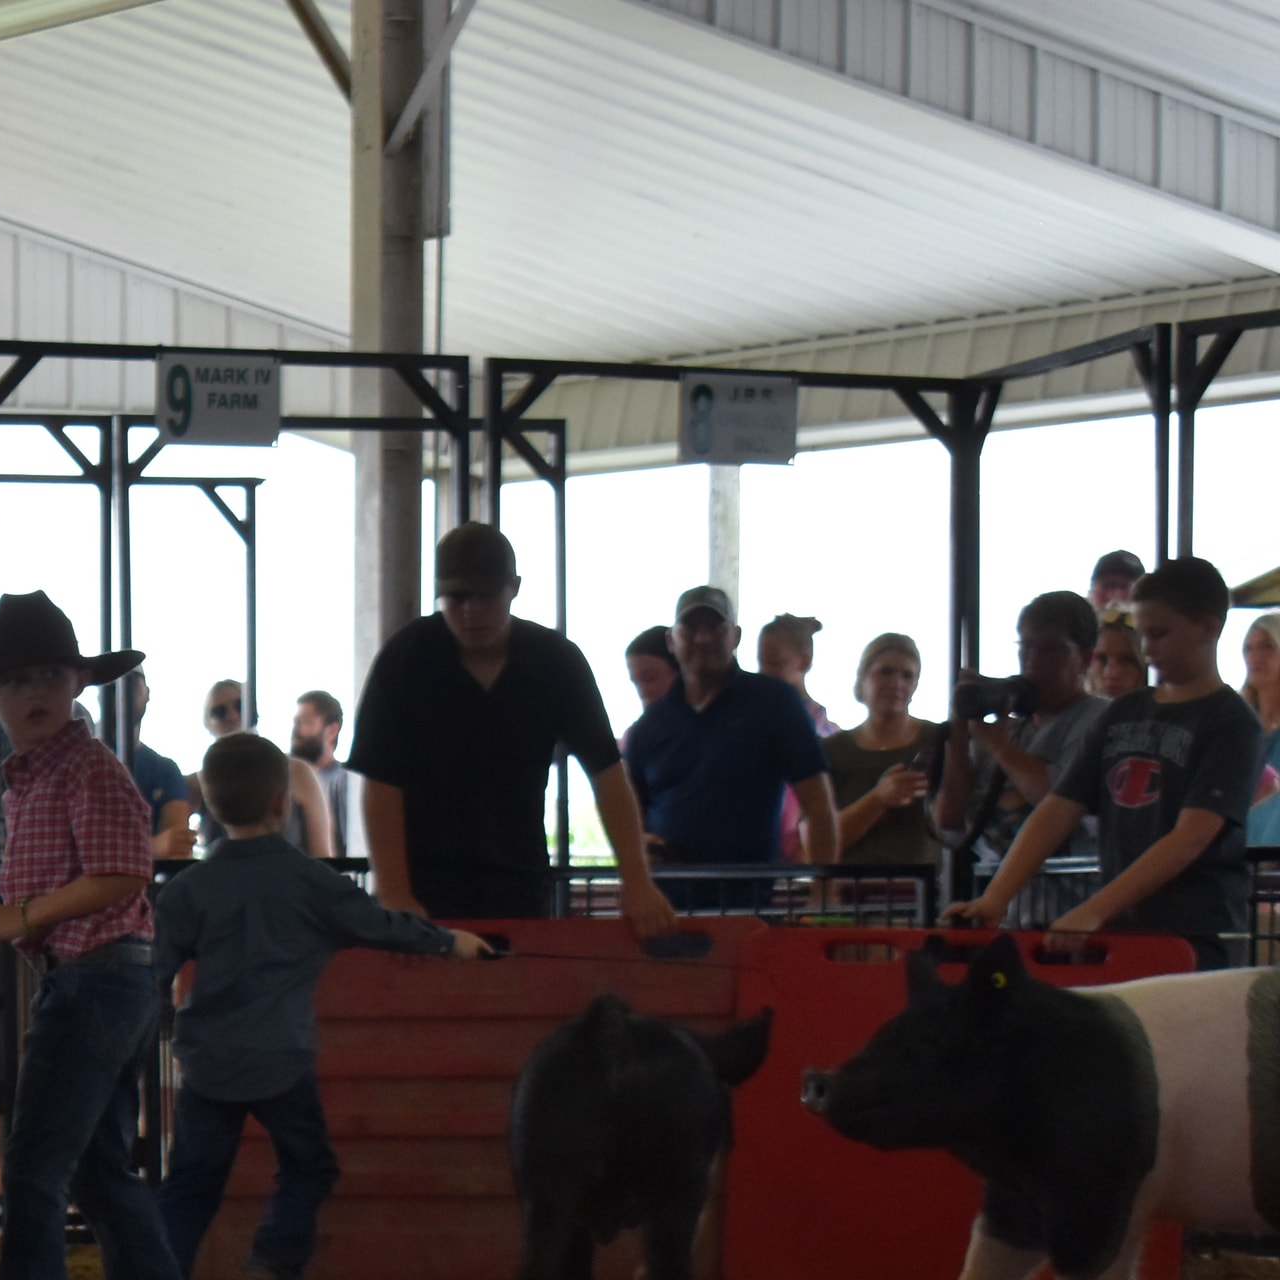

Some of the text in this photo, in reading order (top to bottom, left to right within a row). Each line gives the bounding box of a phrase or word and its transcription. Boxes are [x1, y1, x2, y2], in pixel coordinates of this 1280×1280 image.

[194, 366, 272, 386] MARK IV
[165, 364, 192, 438] 9
[206, 391, 258, 411] FARM
[688, 383, 714, 455] 8
